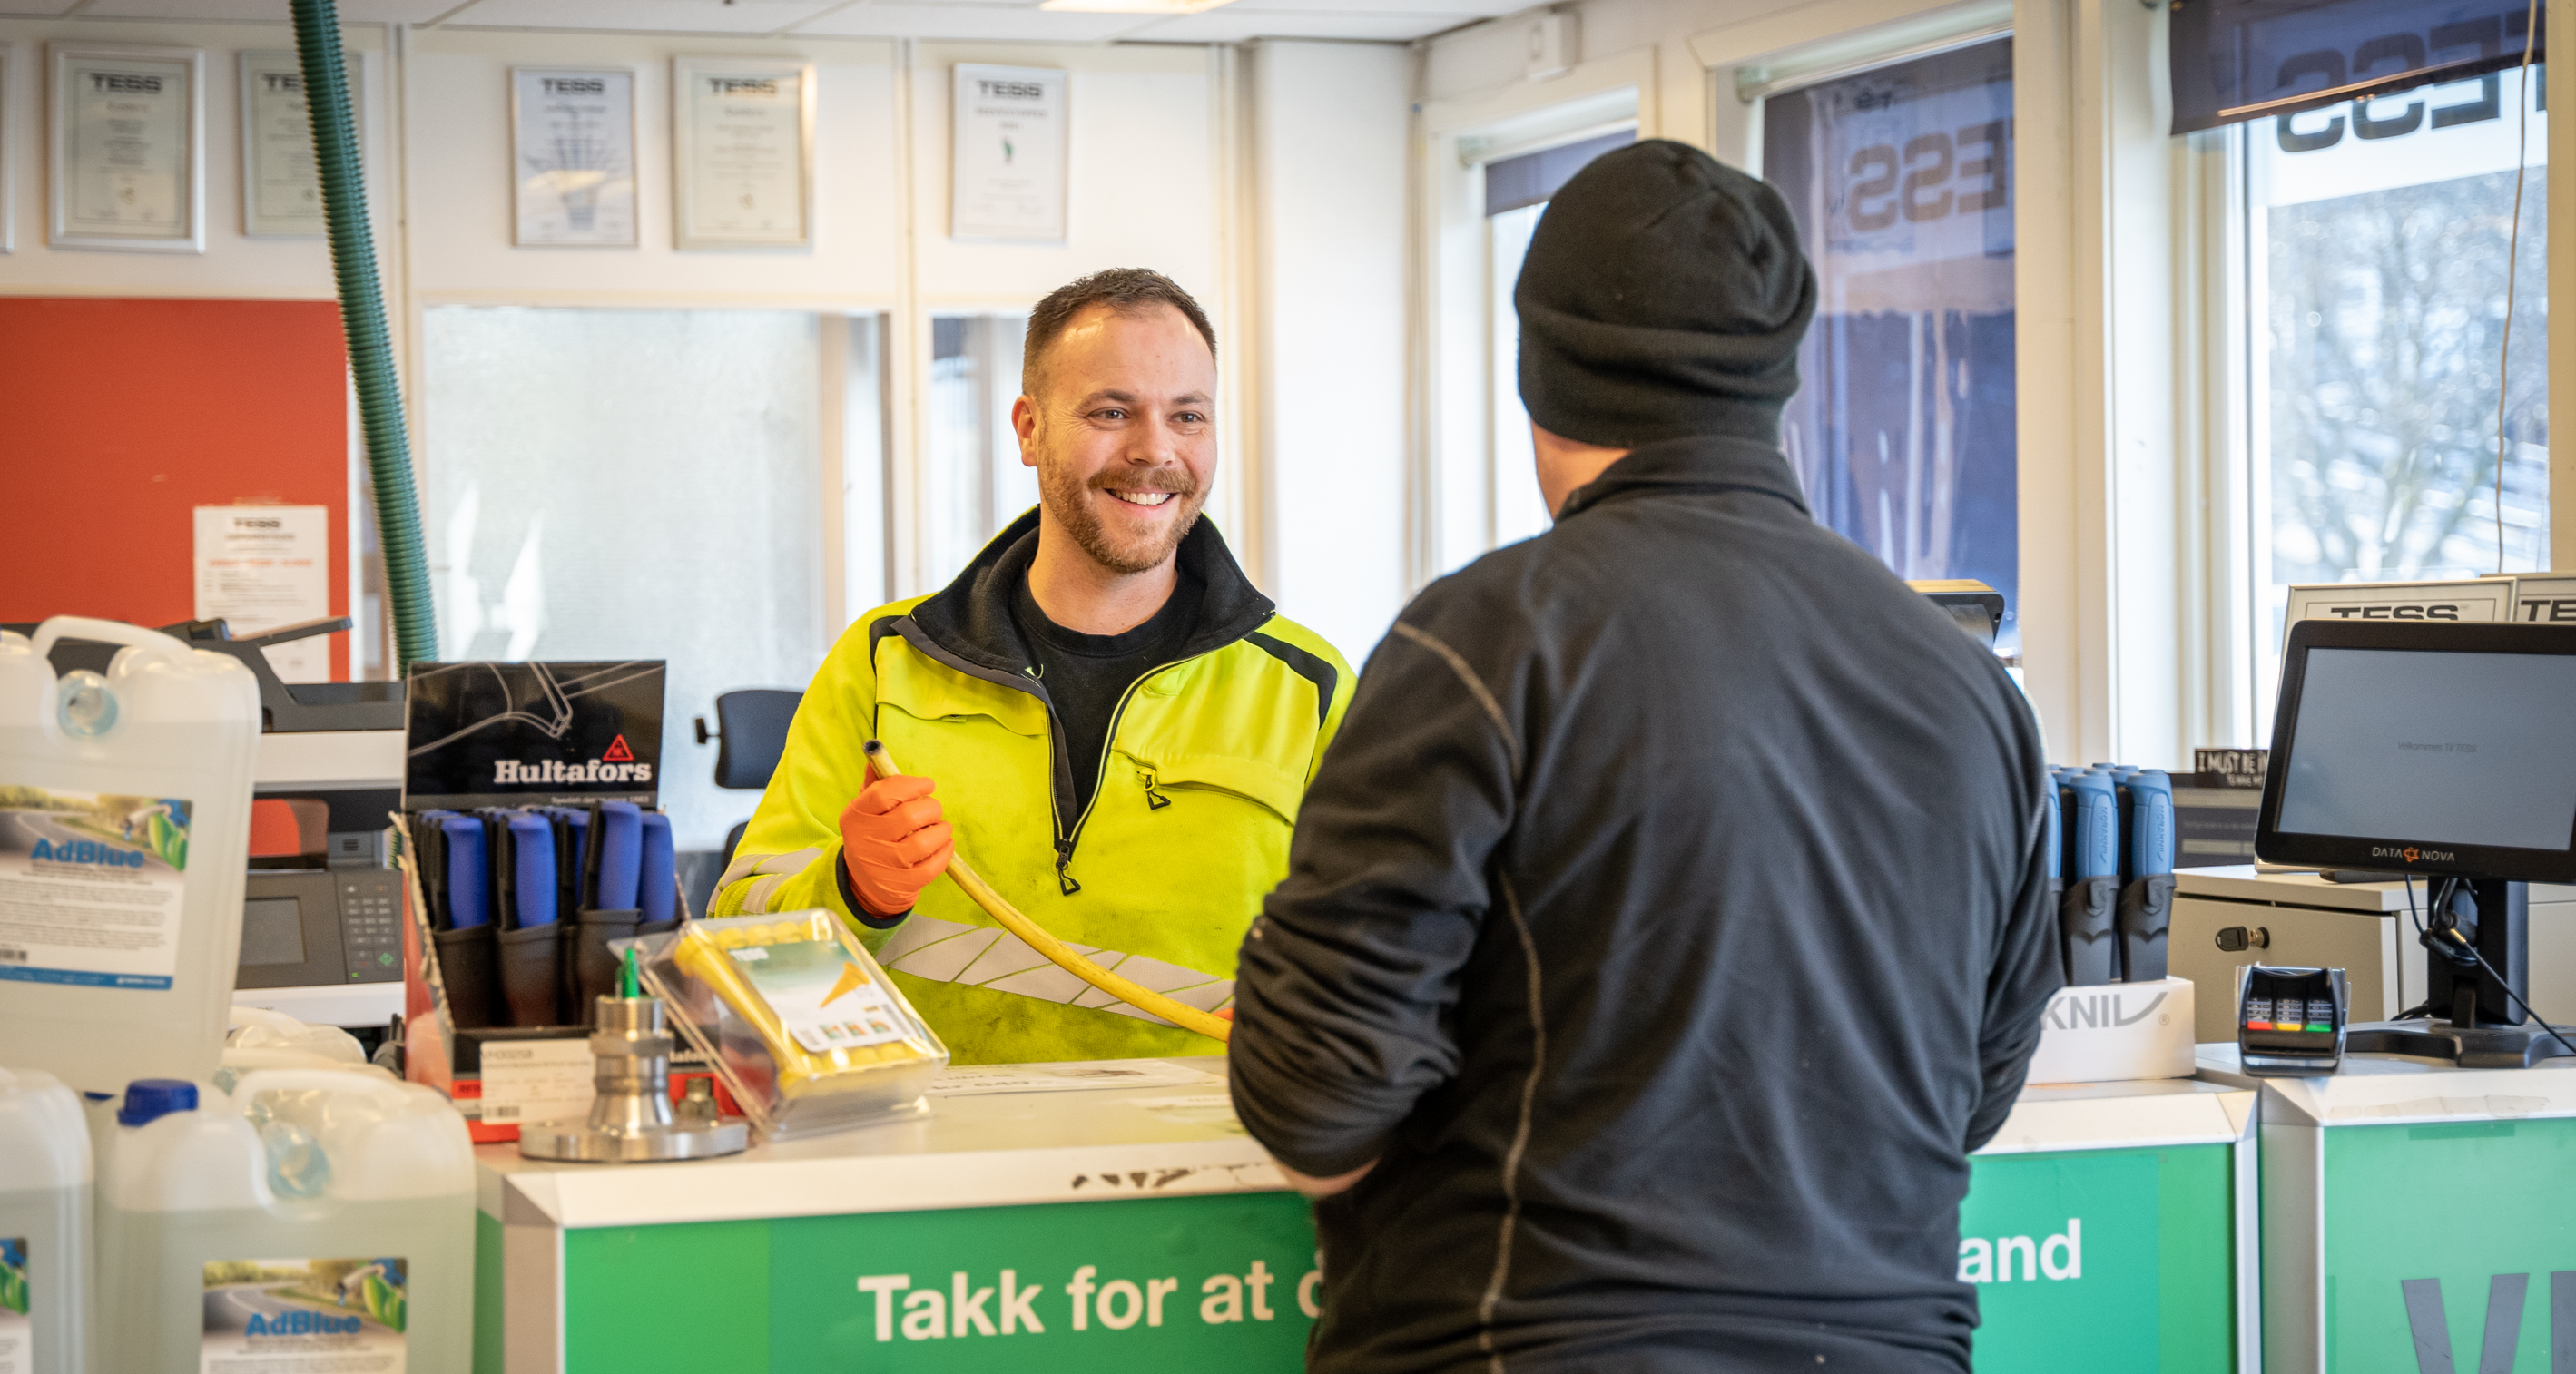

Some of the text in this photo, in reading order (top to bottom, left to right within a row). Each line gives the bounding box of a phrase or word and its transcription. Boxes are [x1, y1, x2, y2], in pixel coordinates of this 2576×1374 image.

[91, 73, 162, 93] TESS
[541, 78, 605, 95] TESS
[708, 77, 778, 95] TESS
[978, 80, 1043, 100] TESS
[2455, 743, 2478, 753] TESS
[493, 759, 654, 784] Hultafors
[2207, 751, 2240, 774] MUST
[2242, 752, 2256, 774] BE
[30, 838, 144, 869] AdBlue
[2371, 847, 2455, 862] DATA NOVA
[1956, 1218, 2081, 1283] and
[857, 1269, 1046, 1342] Takk
[1065, 1265, 1178, 1331] for
[1199, 1260, 1274, 1325] at
[244, 1310, 362, 1337] AdBlue
